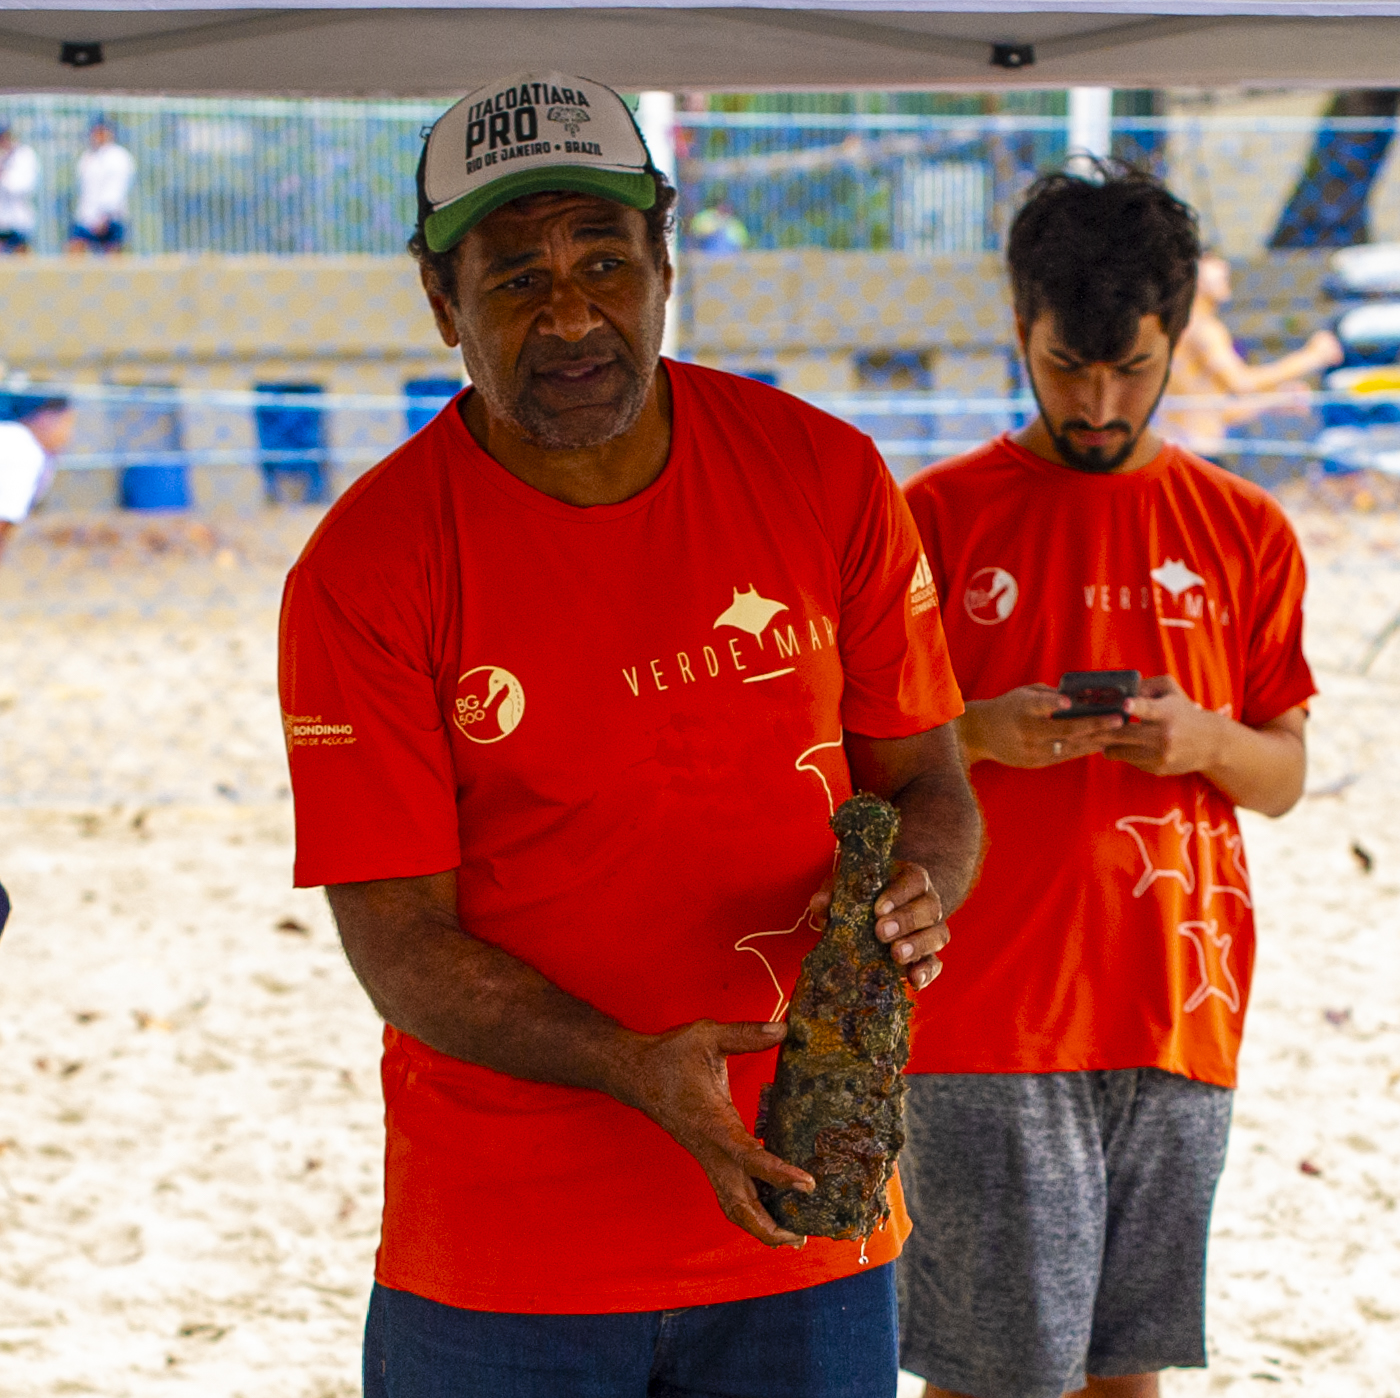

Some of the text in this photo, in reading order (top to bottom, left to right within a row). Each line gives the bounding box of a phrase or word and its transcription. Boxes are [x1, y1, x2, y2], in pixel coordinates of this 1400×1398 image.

[467, 82, 590, 123] ITACOATIARA
[465, 105, 538, 160] PRO
[466, 140, 603, 175] RIO DE JANEIRO BRAZIL
[622, 638, 747, 697] VERDE
[456, 694, 480, 714] BG
[293, 724, 353, 736] BONDINHO
